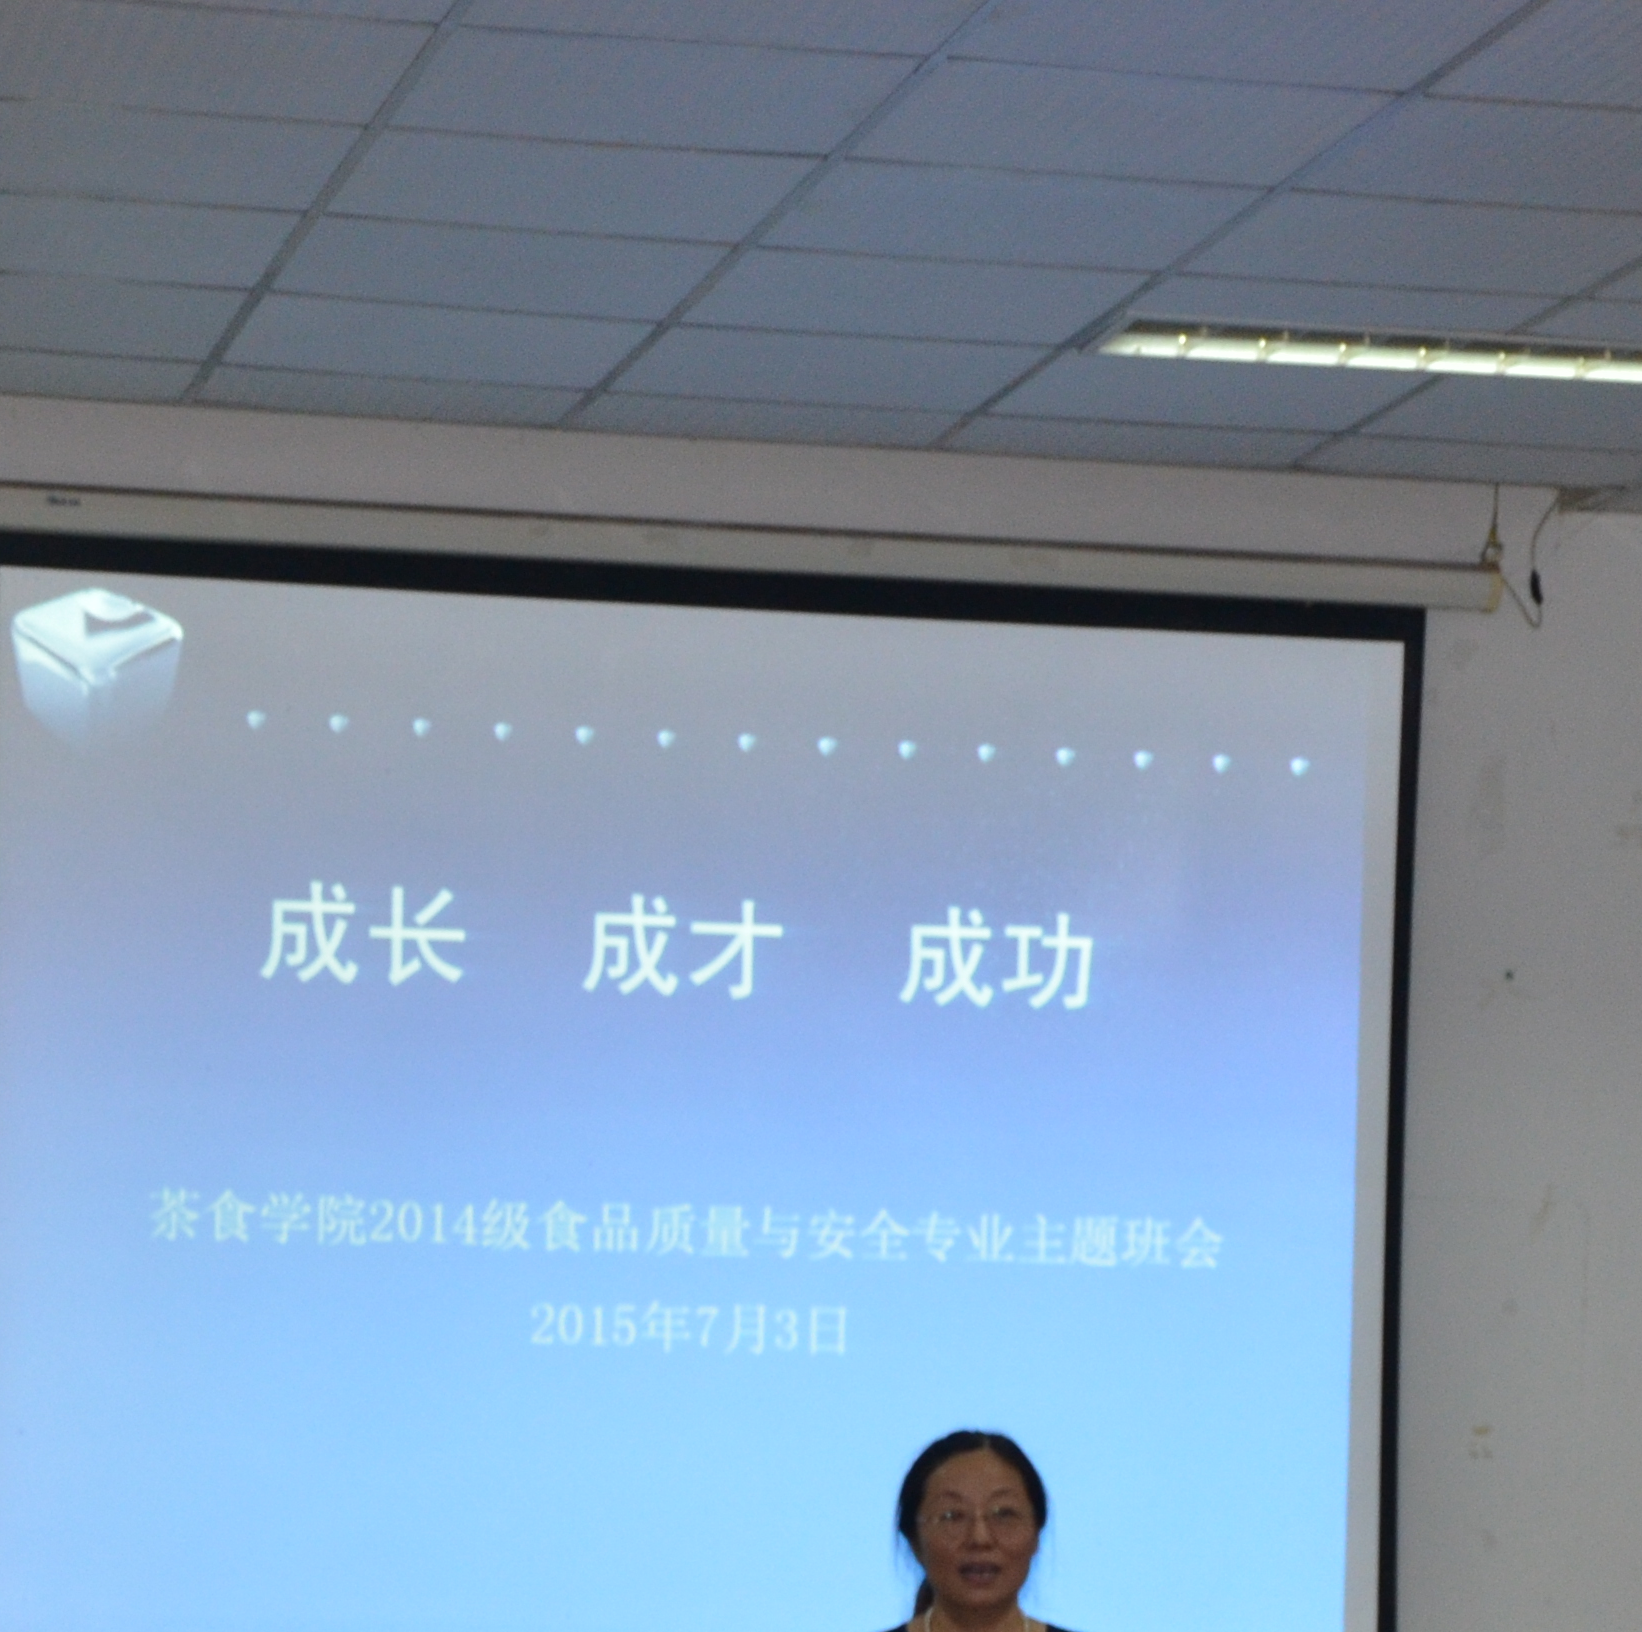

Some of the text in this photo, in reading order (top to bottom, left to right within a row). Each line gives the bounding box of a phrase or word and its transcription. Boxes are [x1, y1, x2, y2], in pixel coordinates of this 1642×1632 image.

[259, 880, 1095, 1011] 成长 成才 成功
[150, 1187, 1224, 1268] 茶食学院2014级食品质量与安全专业主题班会
[530, 1299, 848, 1355] 2015年7月3日
